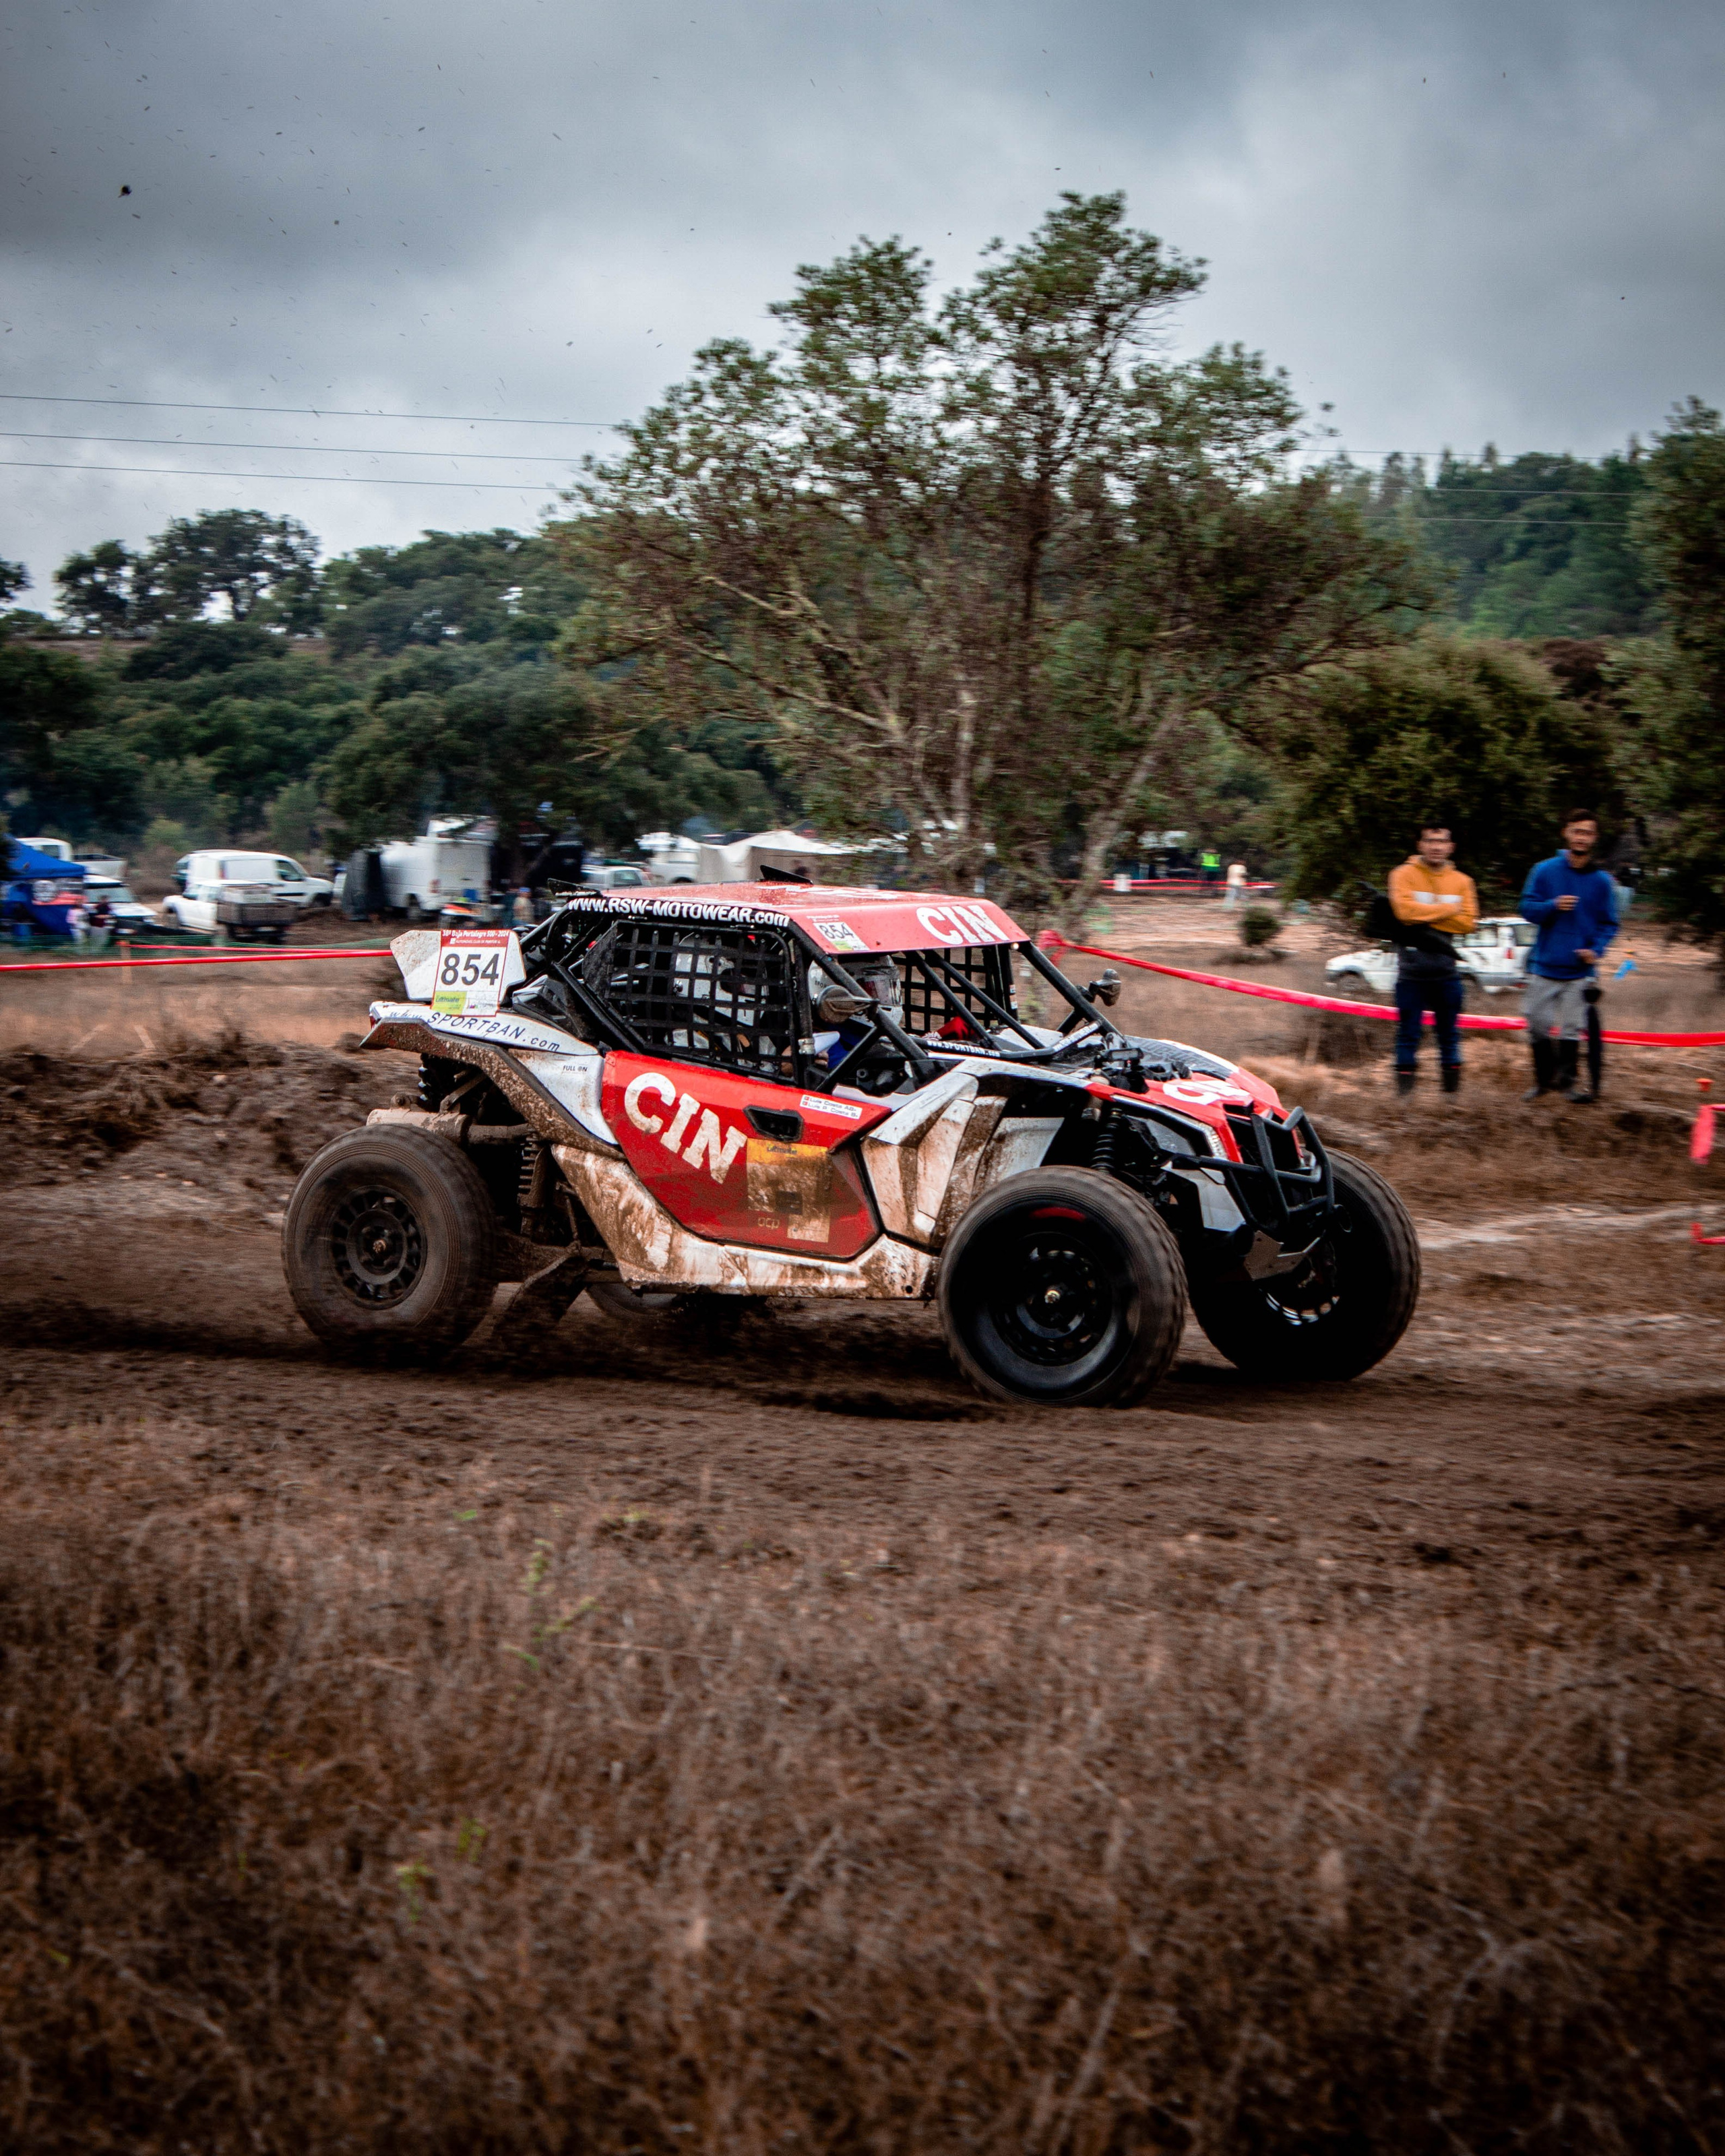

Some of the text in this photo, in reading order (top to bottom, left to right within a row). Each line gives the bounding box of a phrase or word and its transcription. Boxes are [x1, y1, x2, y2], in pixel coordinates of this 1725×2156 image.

[568, 897, 790, 928] www.RSW-MOTOWEAR.com
[916, 905, 1010, 945] CIN
[451, 930, 463, 939] Baja
[463, 930, 487, 939] Portalegre
[819, 922, 854, 939] 854
[441, 953, 499, 986] 854
[624, 1072, 748, 1184] CIN
